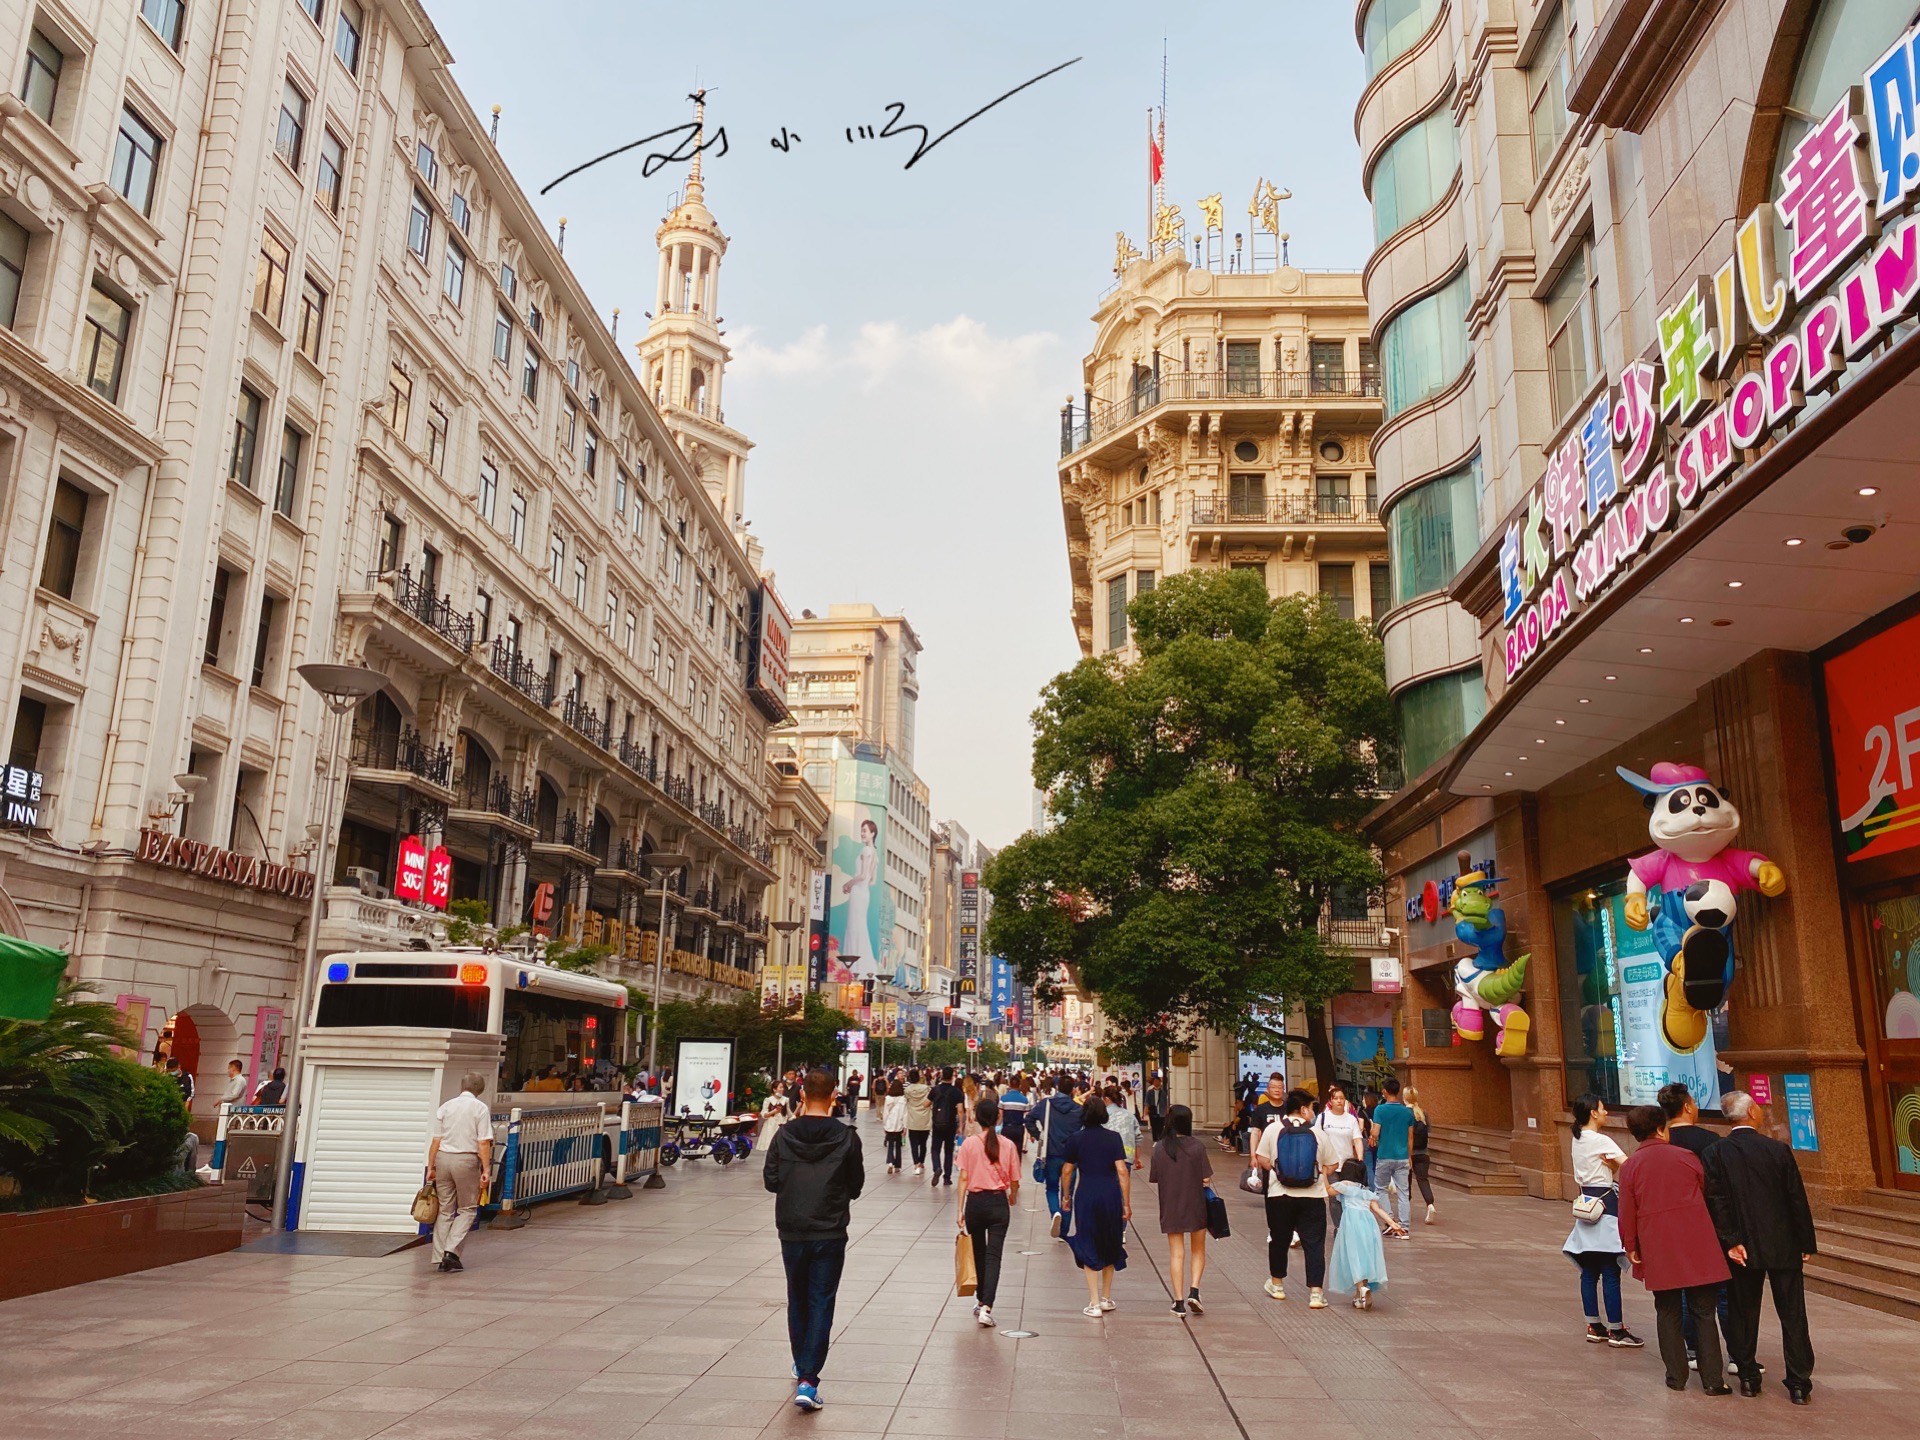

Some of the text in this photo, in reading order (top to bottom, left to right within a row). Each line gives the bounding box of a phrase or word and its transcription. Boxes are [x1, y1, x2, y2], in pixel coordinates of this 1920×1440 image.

[1505, 604, 1540, 683] BAO
[1540, 566, 1571, 641] DA
[1572, 461, 1670, 601] XIANG
[7, 803, 38, 826] INN
[140, 828, 316, 900] EAST ASIA HOTE
